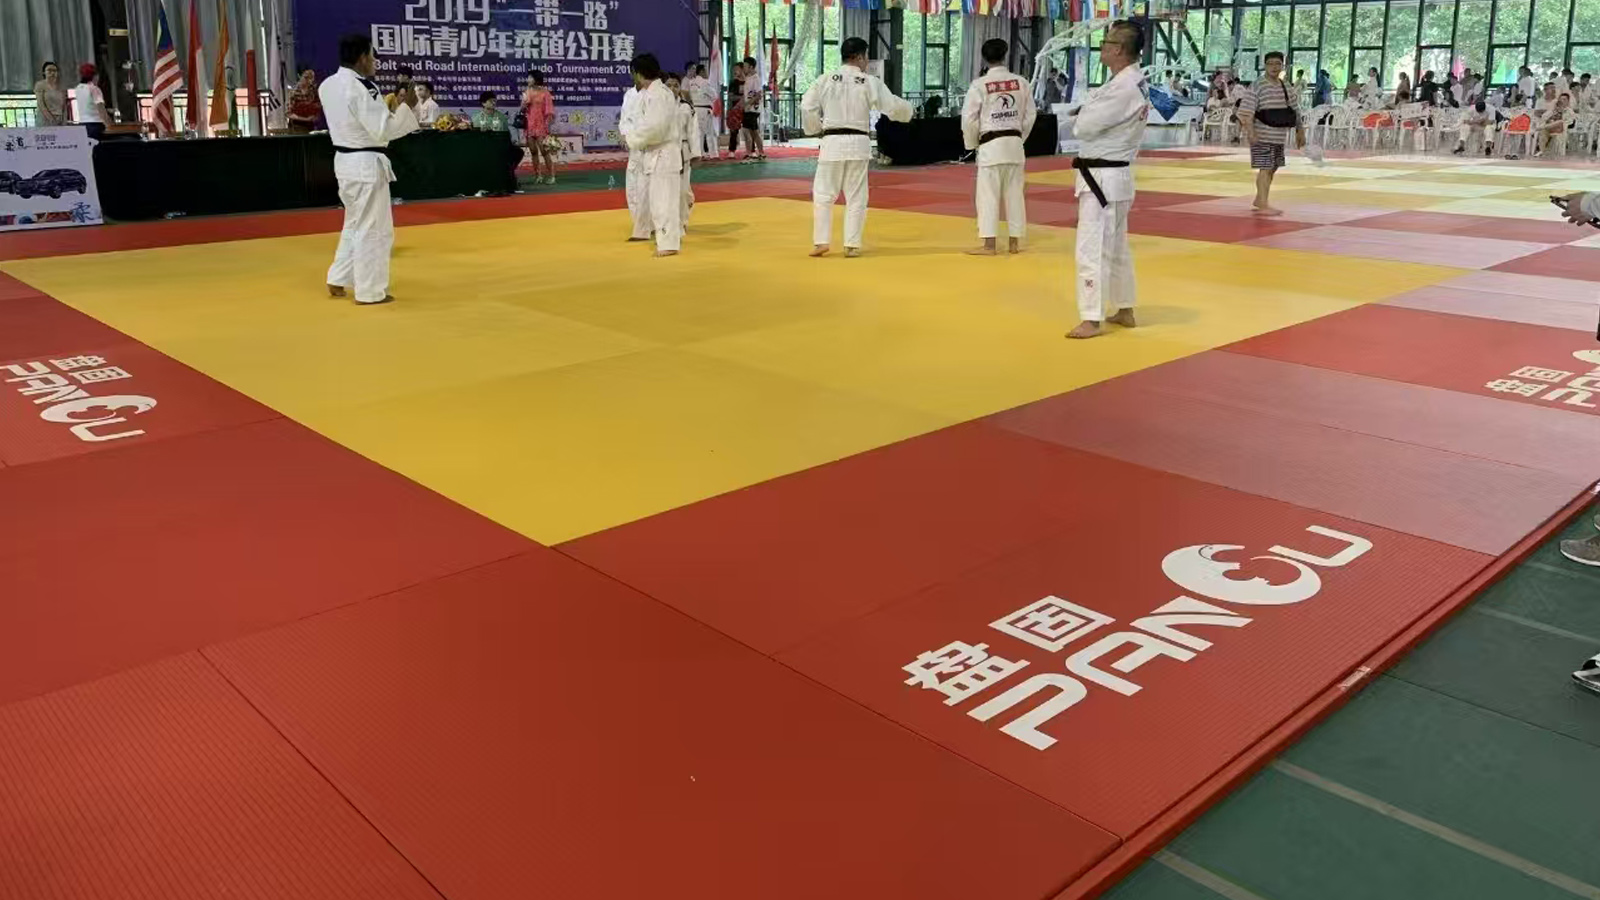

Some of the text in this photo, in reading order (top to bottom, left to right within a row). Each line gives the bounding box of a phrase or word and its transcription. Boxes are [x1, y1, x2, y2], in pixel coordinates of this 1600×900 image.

[371, 23, 635, 61] 国际青少年柔道公开赛
[425, 60, 454, 71] Road
[458, 61, 526, 73] International
[556, 63, 614, 74] Tournament
[616, 65, 631, 74] 201
[901, 595, 1116, 707] 盘固
